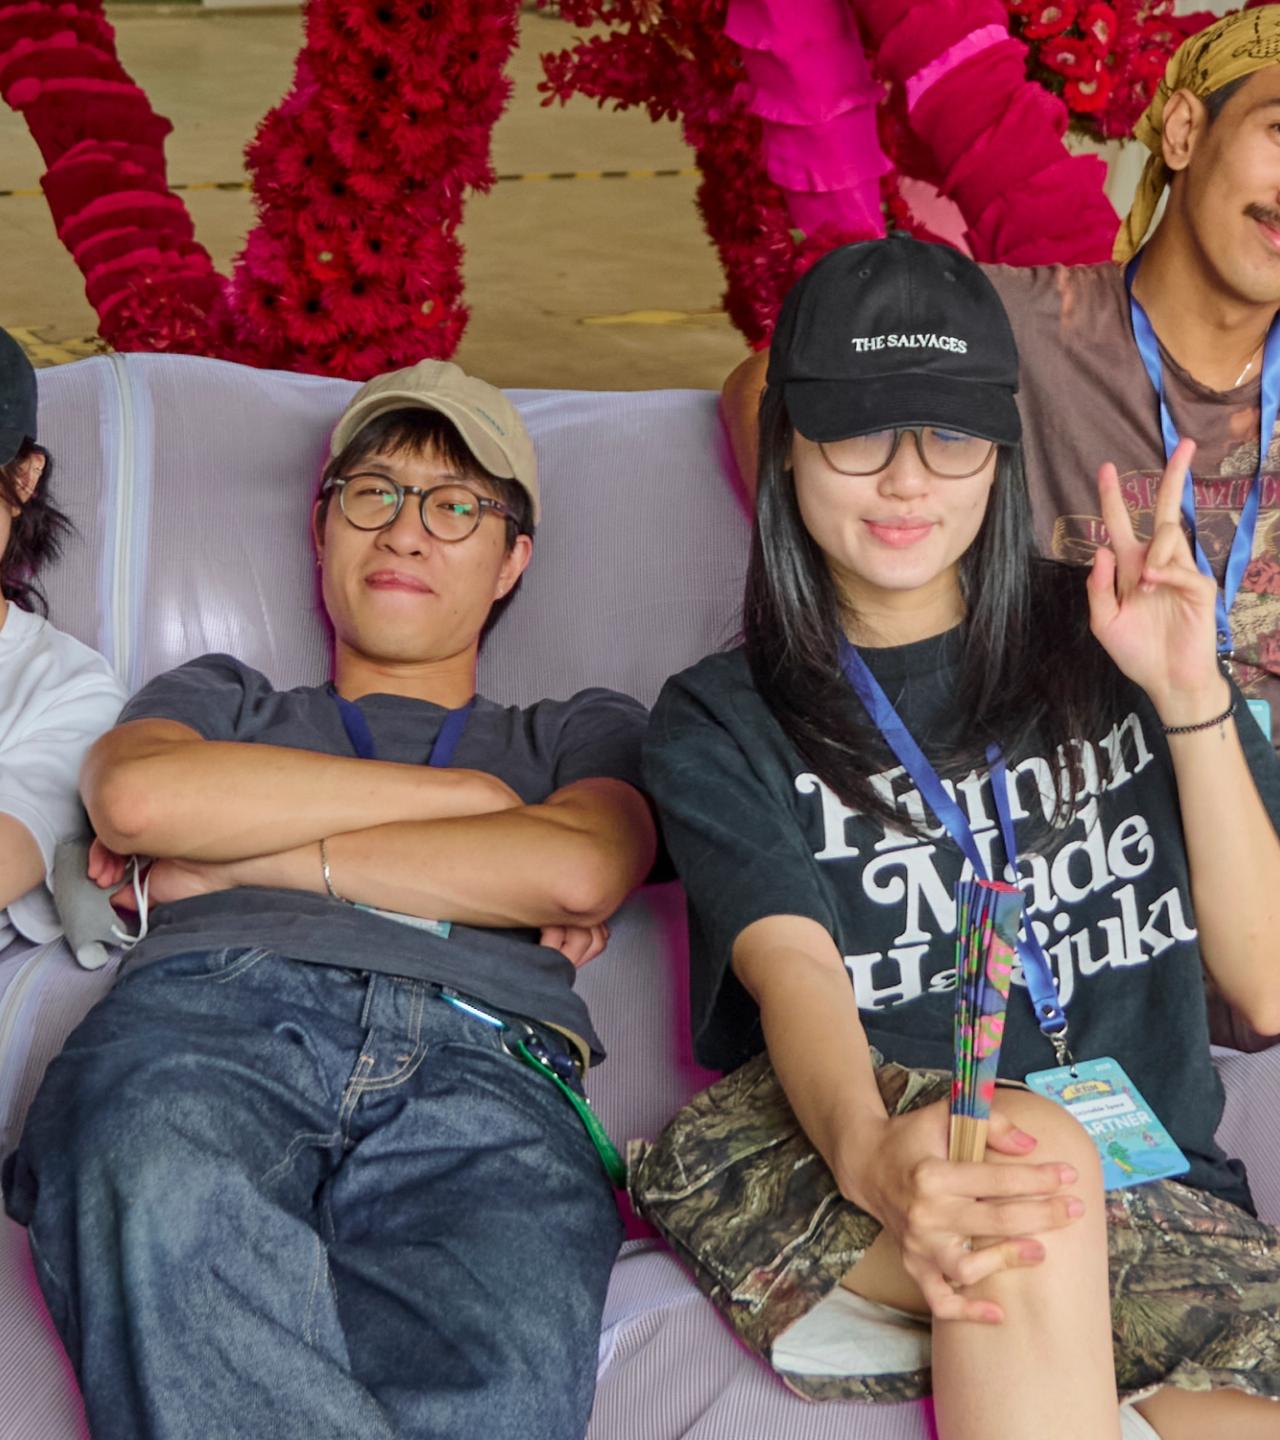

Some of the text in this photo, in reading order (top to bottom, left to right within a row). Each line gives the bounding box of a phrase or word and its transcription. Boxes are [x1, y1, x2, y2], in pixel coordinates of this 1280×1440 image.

[851, 333, 968, 354] THE SALVAGES
[1084, 1110, 1153, 1136] ARTNER
